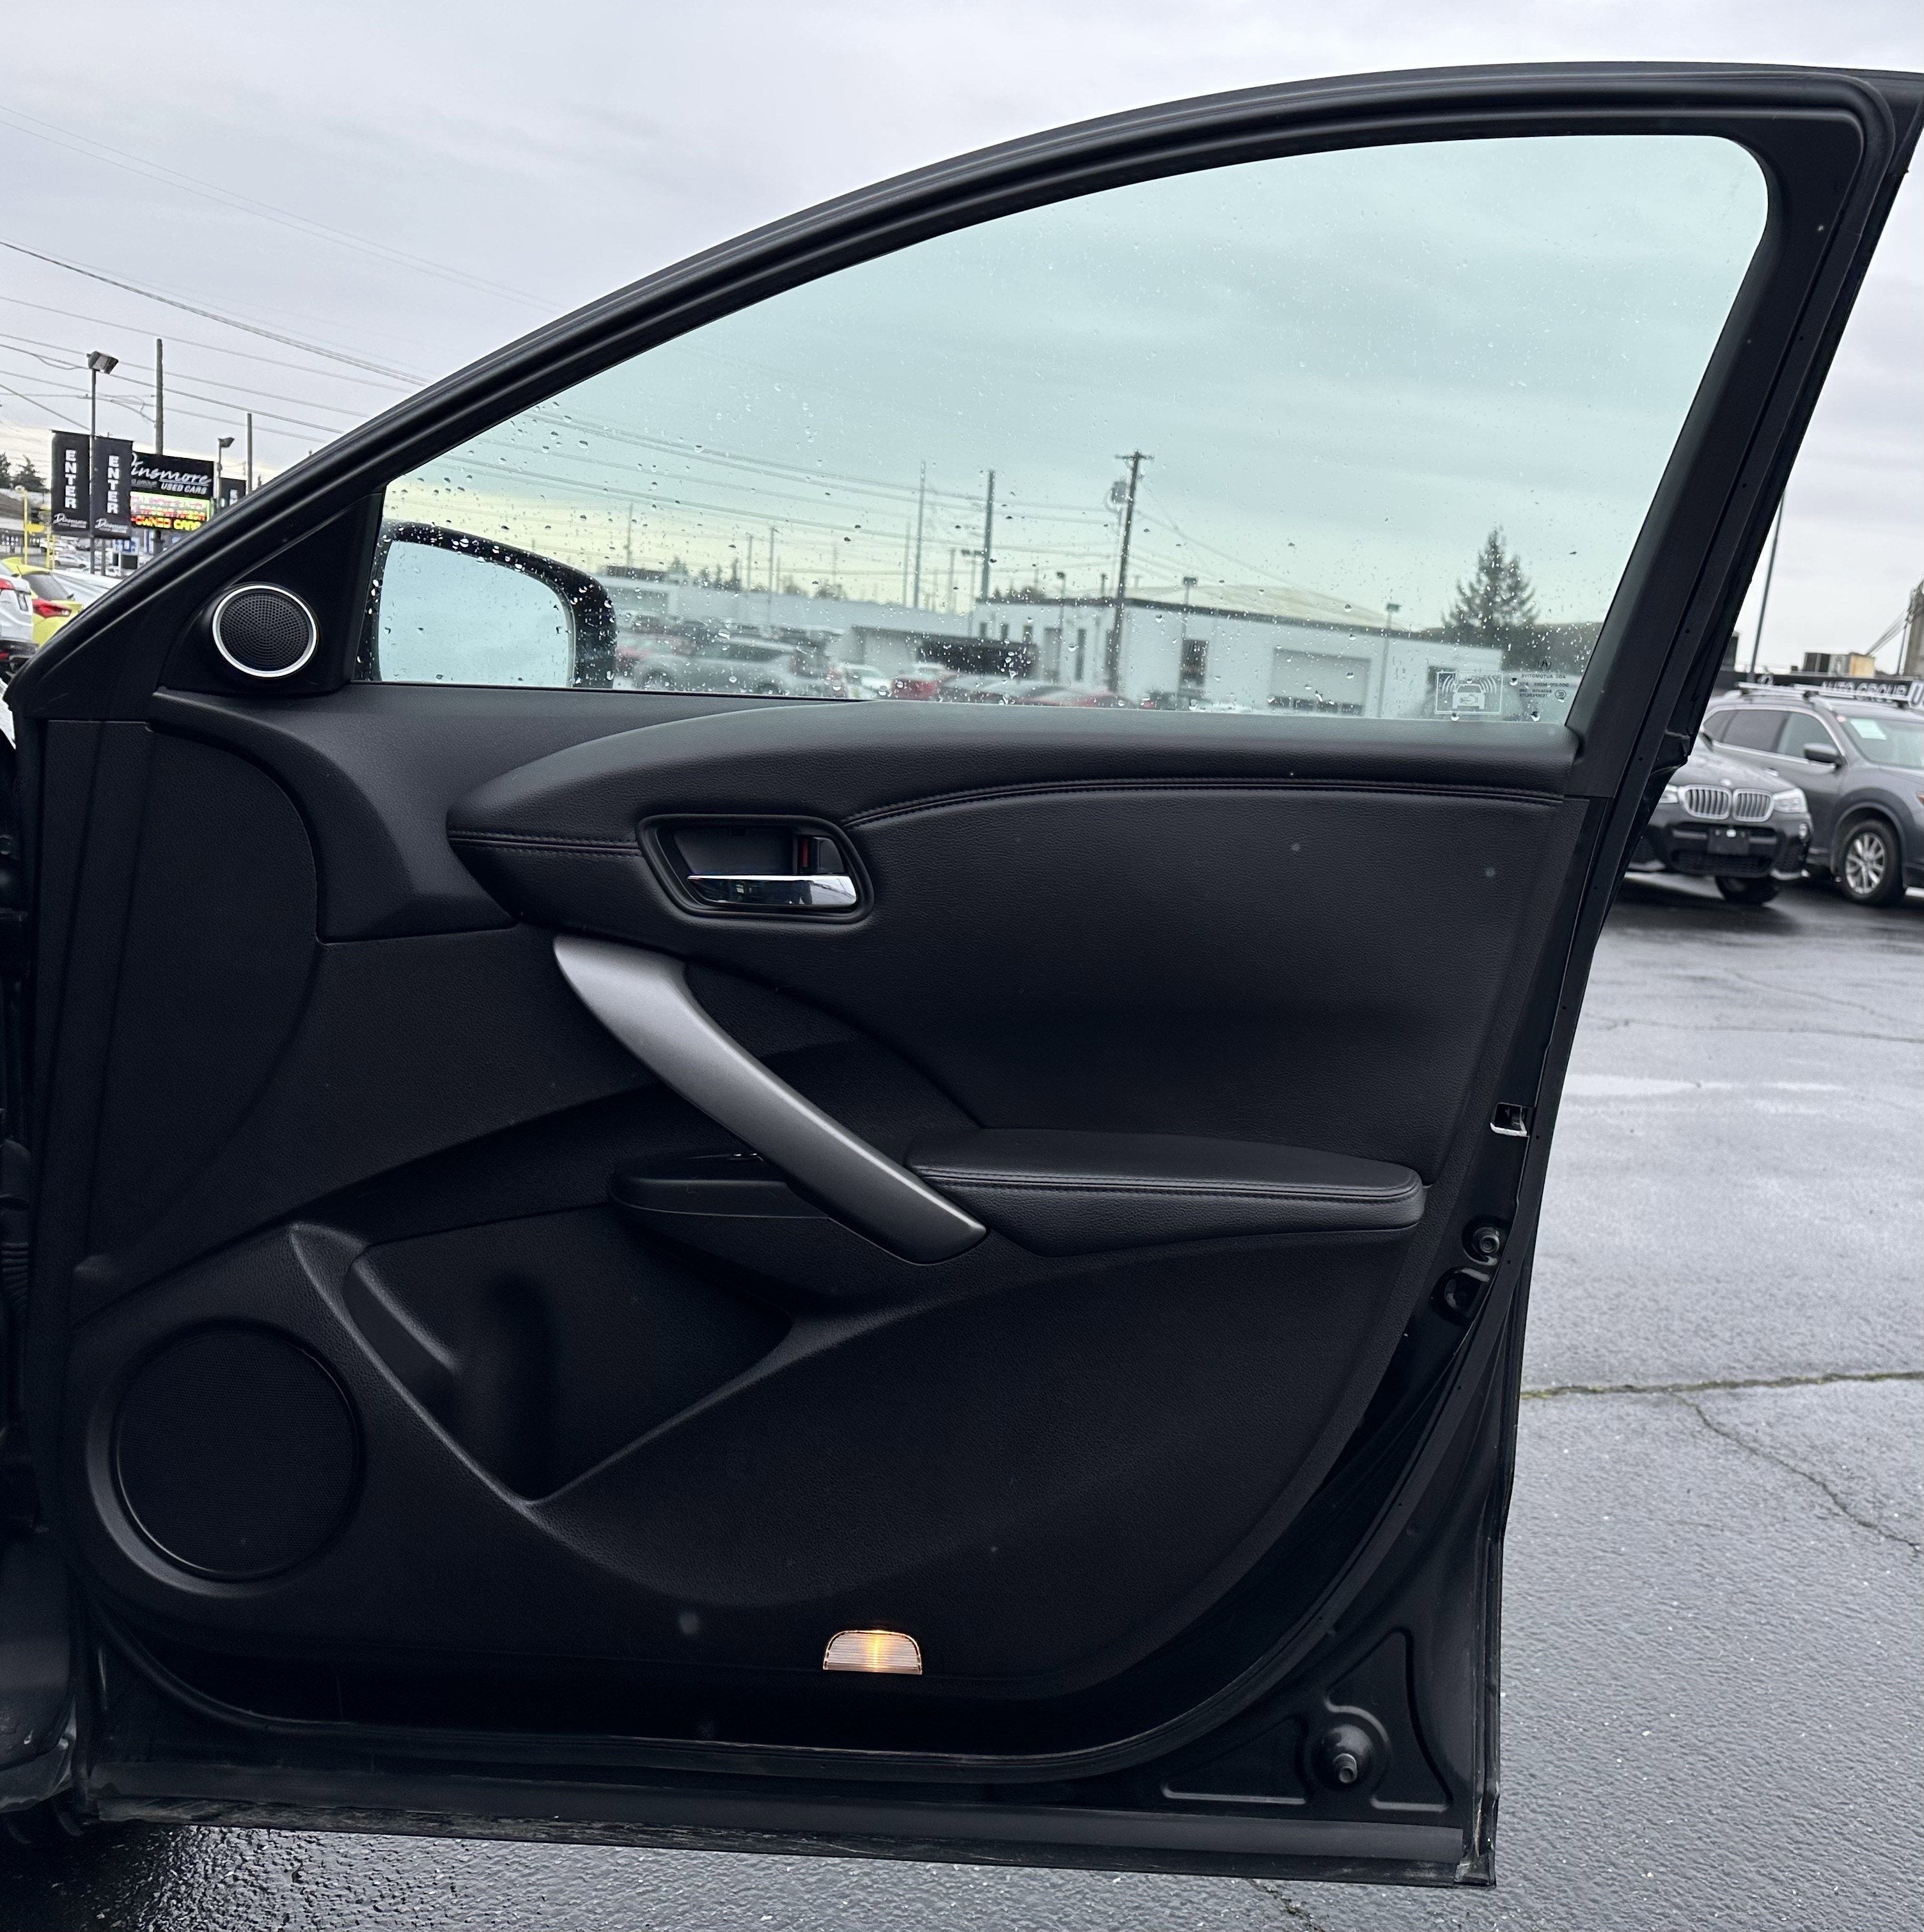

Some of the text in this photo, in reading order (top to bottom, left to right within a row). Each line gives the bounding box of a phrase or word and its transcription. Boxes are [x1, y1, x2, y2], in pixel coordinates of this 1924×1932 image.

[65, 449, 77, 509] ENTER
[107, 455, 120, 514] ENTER
[161, 483, 184, 492] USED
[184, 485, 207, 495] CARS
